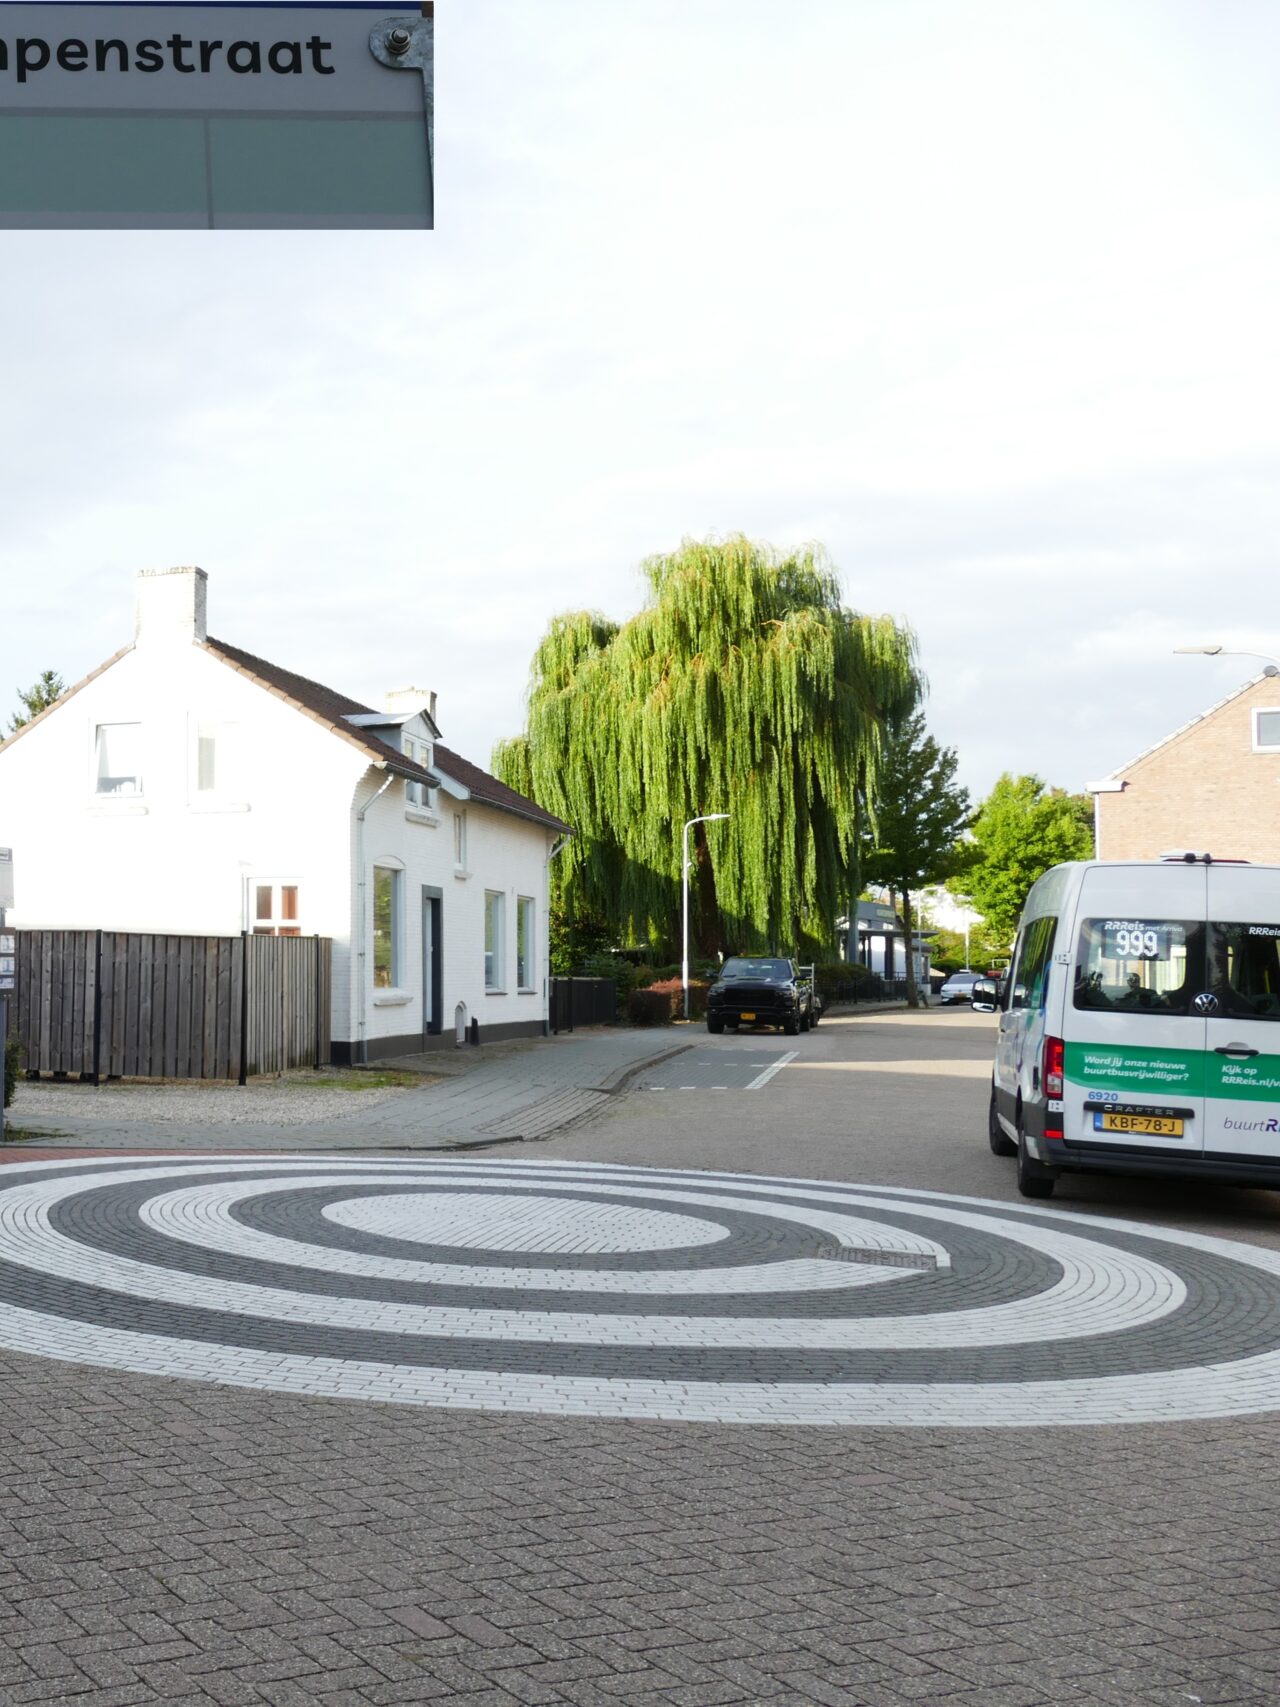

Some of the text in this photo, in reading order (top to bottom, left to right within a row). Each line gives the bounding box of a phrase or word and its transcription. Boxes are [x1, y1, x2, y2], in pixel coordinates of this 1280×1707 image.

[1104, 921, 1144, 931] RRReis
[1116, 930, 1158, 956] 999
[1084, 1055, 1111, 1065] Word
[1111, 1057, 1122, 1067] jij
[1149, 1060, 1186, 1070] nieuwe
[1083, 1066, 1189, 1081] buurtbusvrijwilliger?
[1222, 1065, 1258, 1076] Kijk op
[1088, 1091, 1118, 1102] 6920
[1104, 1104, 1175, 1116] CRAFTER
[1109, 1116, 1176, 1132] KBF-78-J
[1223, 1117, 1280, 1132] buurtR
